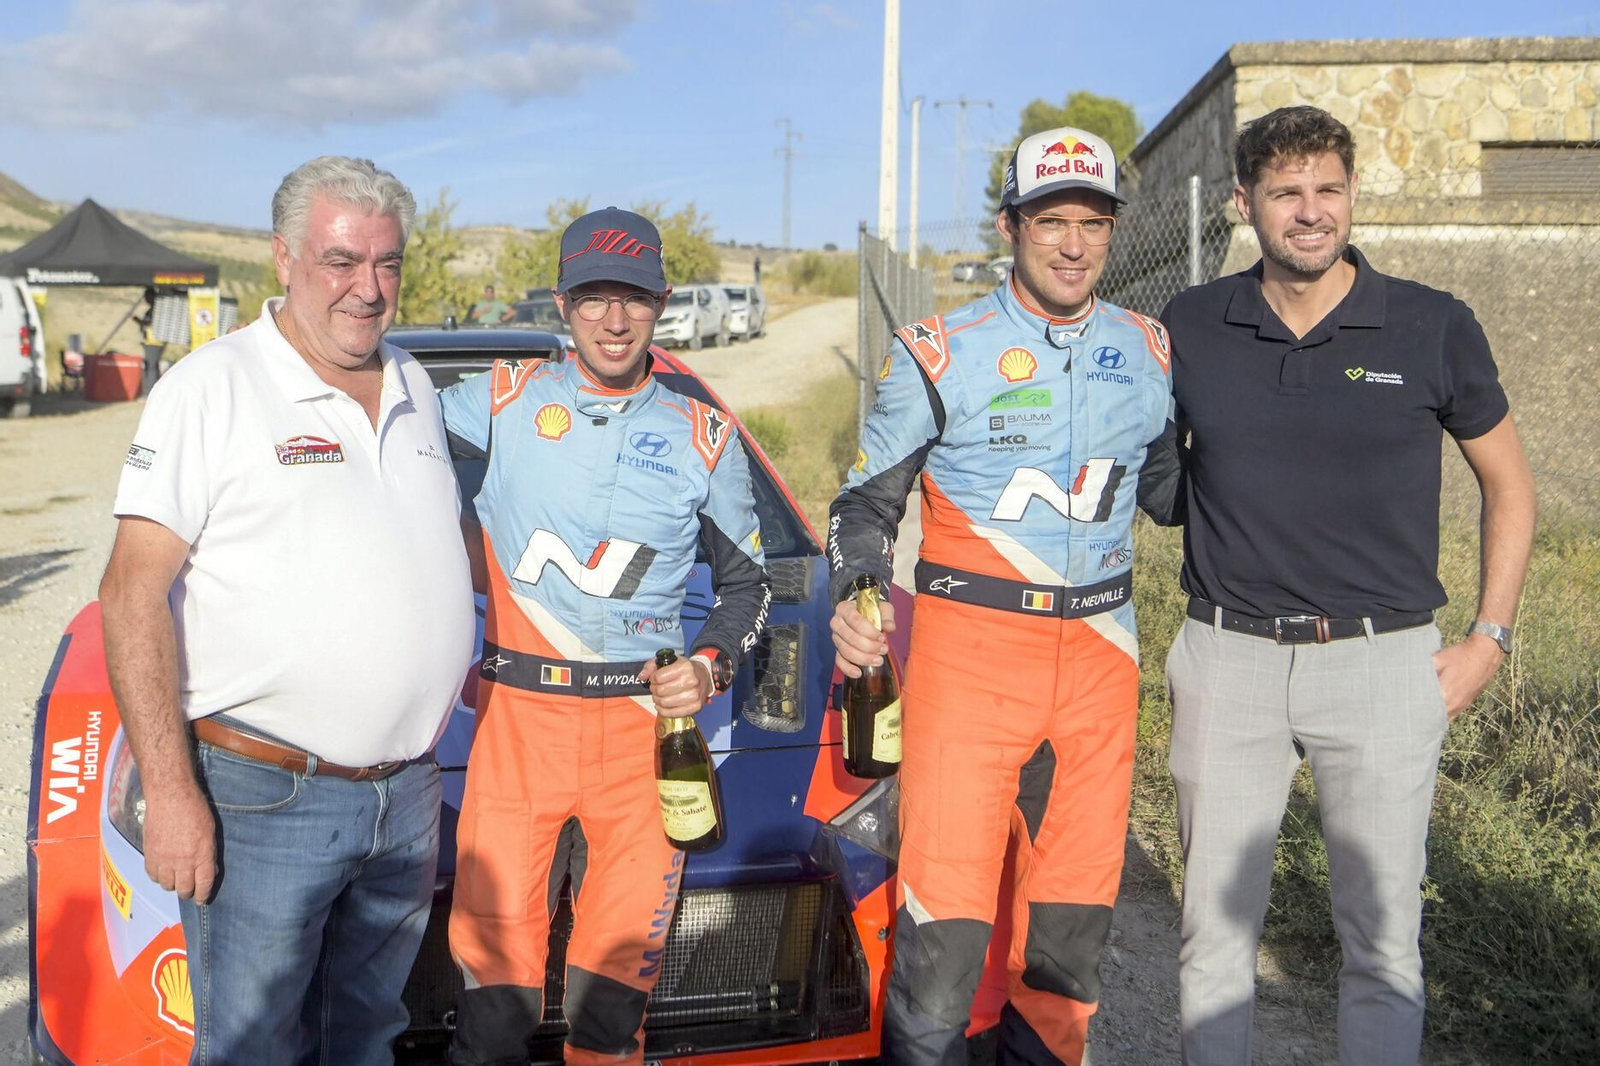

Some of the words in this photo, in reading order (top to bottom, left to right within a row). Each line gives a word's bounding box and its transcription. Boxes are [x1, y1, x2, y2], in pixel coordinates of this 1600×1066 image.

[1036, 159, 1071, 179] Red
[1074, 160, 1104, 179] Bull
[1086, 372, 1134, 386] HYUNDAI
[1365, 371, 1402, 380] Diputación
[1375, 377, 1404, 385] Granada
[1007, 413, 1052, 424] BAUMA
[988, 434, 1028, 445] LKQ
[988, 445, 1015, 453] Keeping
[1028, 444, 1052, 452] moving
[279, 450, 342, 465] Granada
[616, 452, 678, 476] HYUNDAI
[1070, 598, 1080, 610] T.
[1080, 587, 1124, 608] NEUVILLE
[586, 675, 600, 687] M.
[83, 711, 102, 781] HYUNDAI
[648, 850, 684, 939] Wyda
